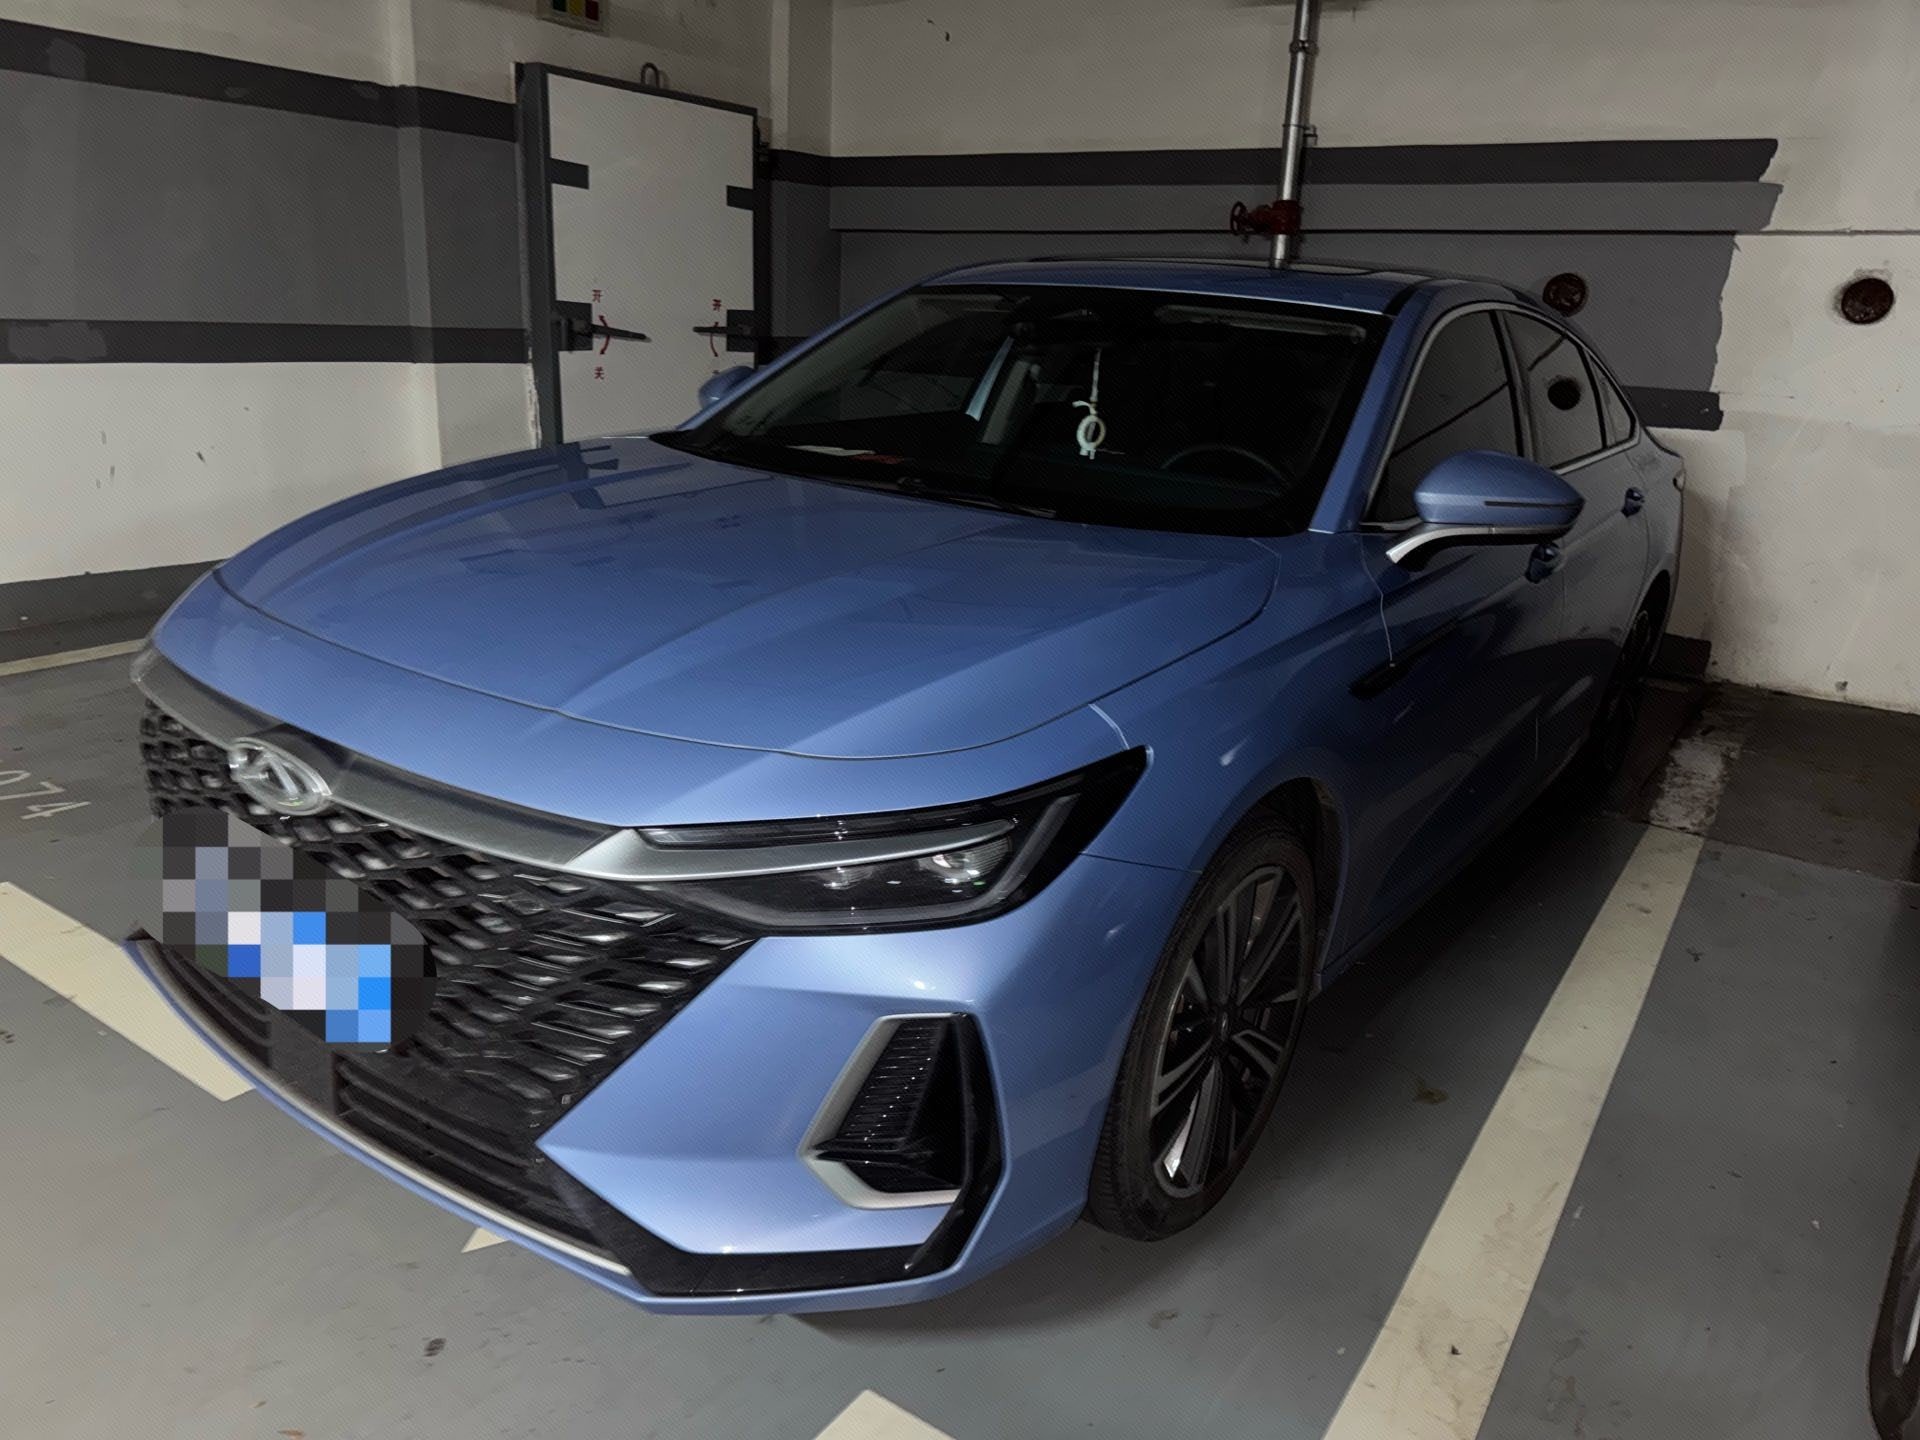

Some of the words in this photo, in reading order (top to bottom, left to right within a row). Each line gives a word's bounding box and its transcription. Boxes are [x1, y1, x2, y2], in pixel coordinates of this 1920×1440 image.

[592, 289, 602, 303] 开
[712, 298, 722, 312] 开
[594, 366, 604, 380] 关
